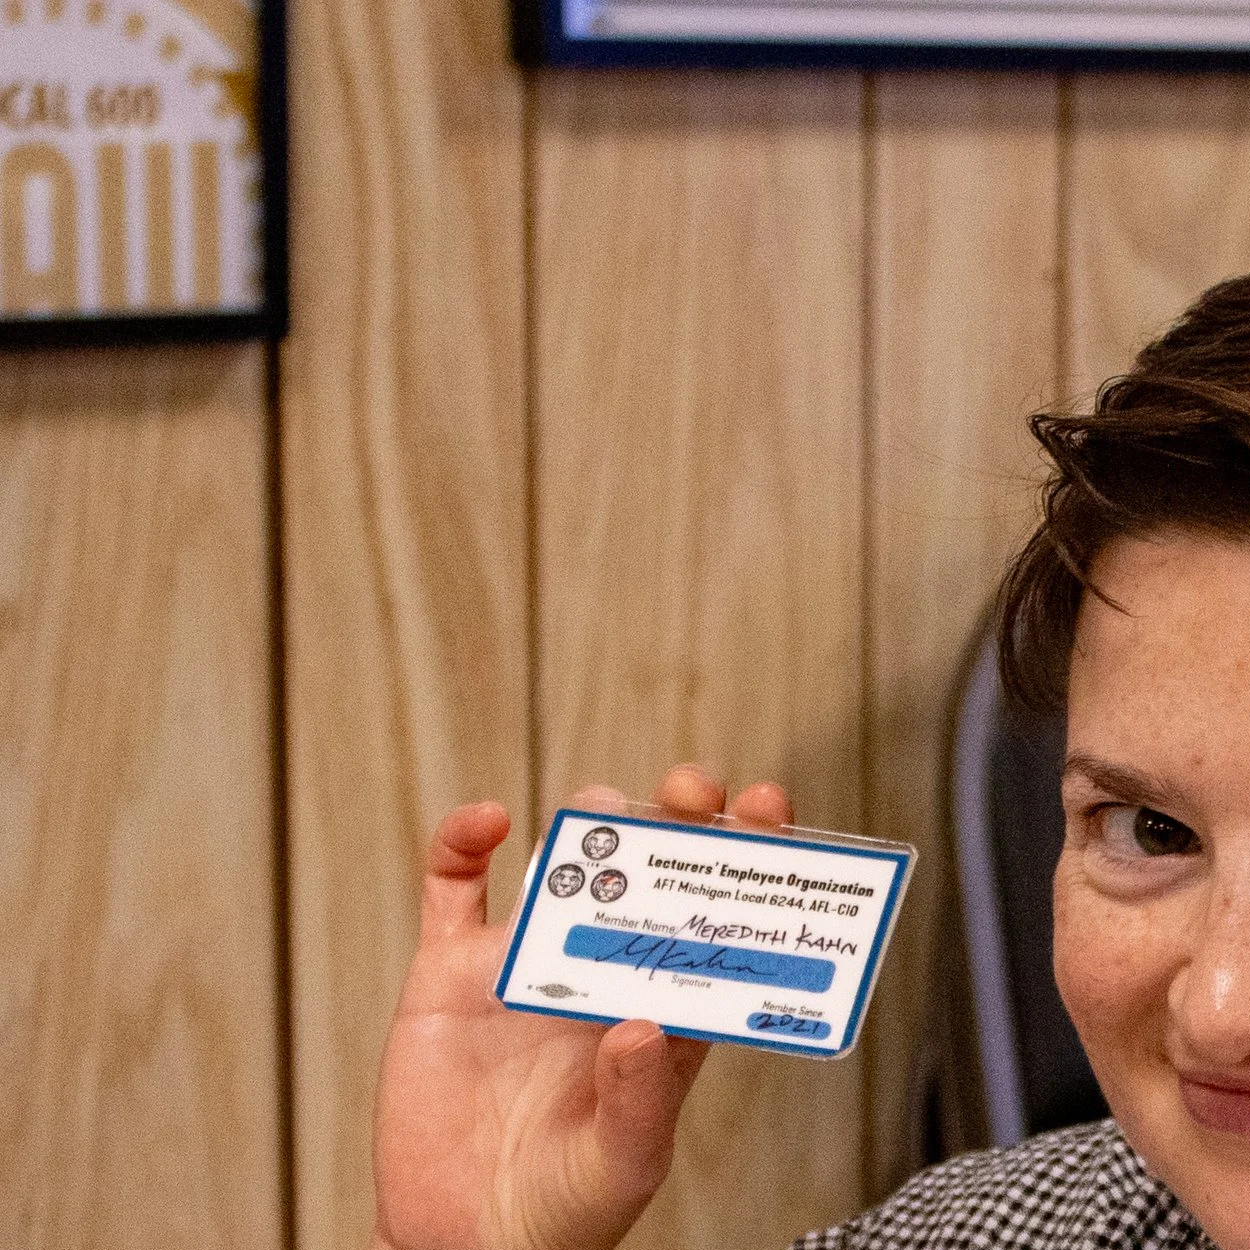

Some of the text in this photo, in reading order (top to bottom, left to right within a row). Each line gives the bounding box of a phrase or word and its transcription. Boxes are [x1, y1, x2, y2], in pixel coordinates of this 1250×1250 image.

[719, 863, 784, 886] Employee
[786, 873, 875, 898] Organization
[653, 877, 860, 918] AFT Michigan Local 6244, AFL-CIO
[593, 911, 640, 928] Member
[672, 914, 859, 956] MEREDITH KAHN
[670, 974, 713, 989] Signature
[762, 1000, 824, 1018] Member Since
[755, 1013, 820, 1035] 2021
